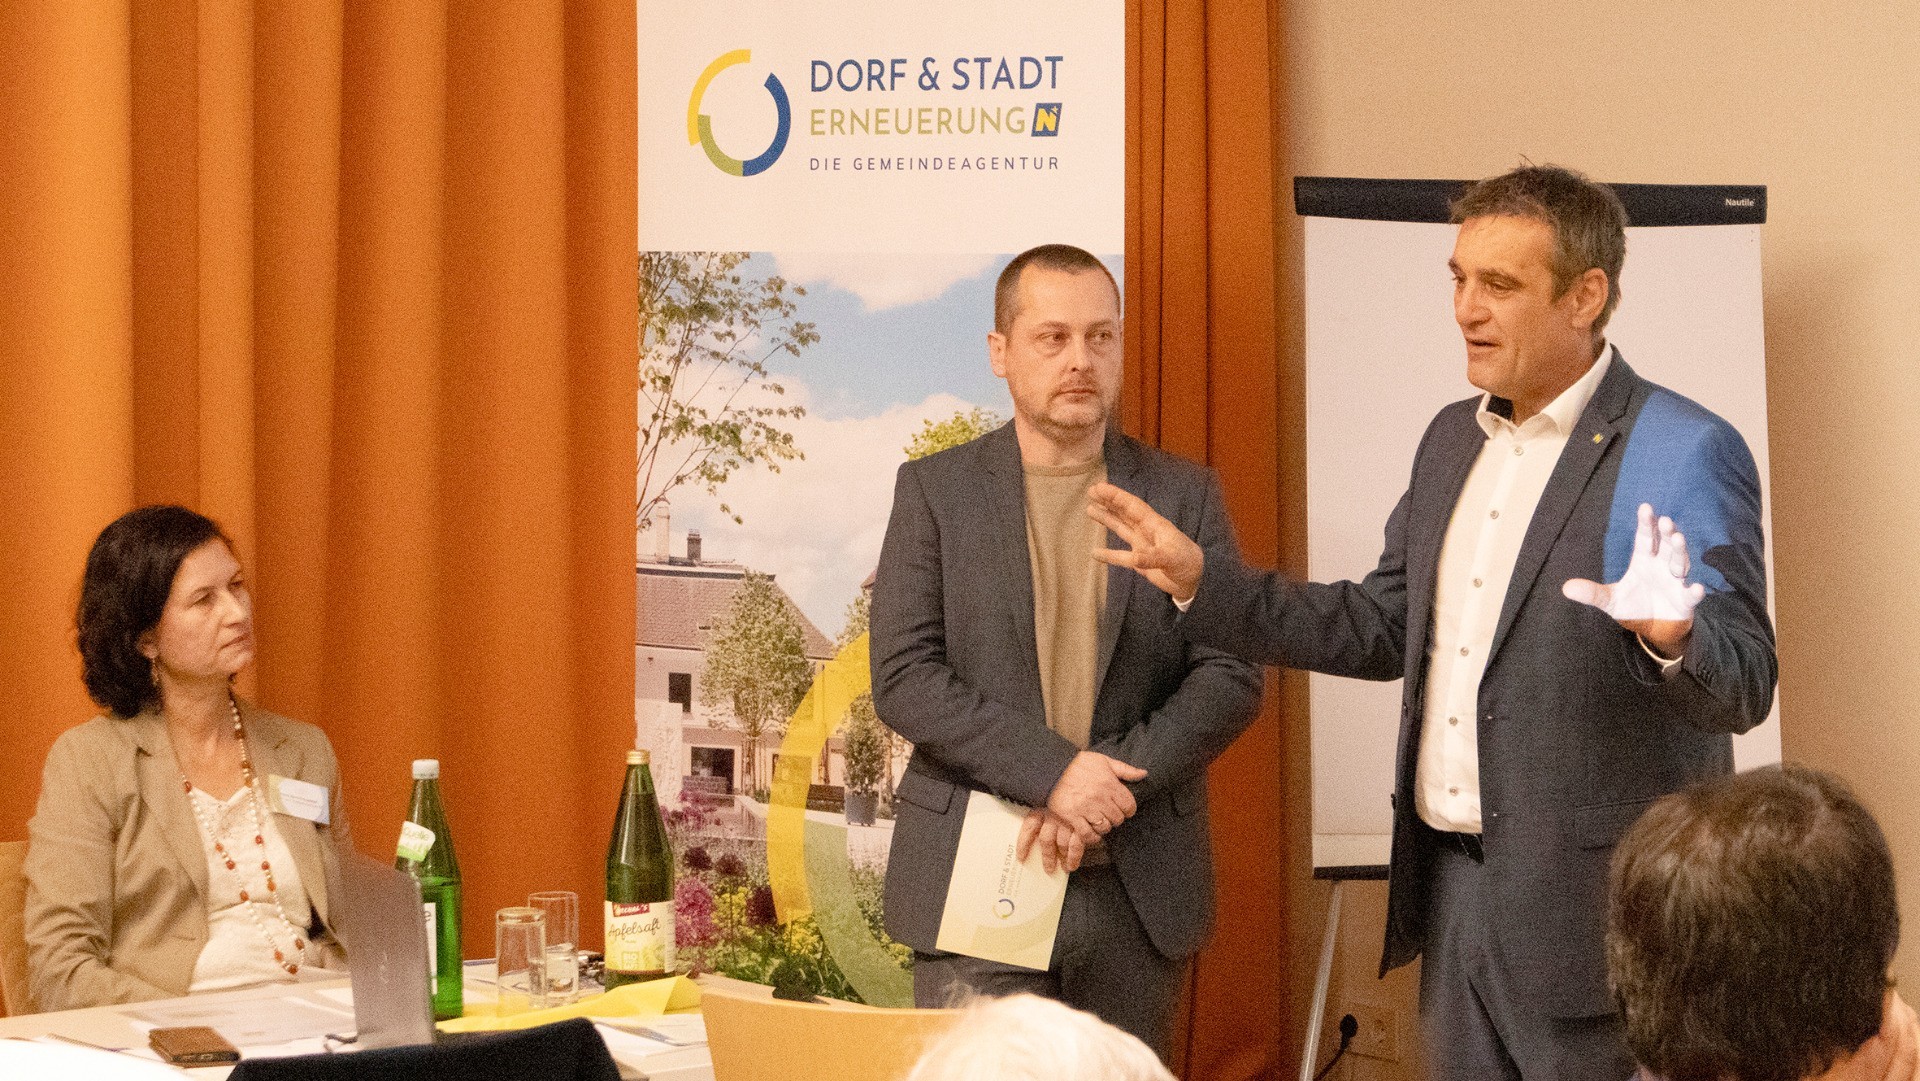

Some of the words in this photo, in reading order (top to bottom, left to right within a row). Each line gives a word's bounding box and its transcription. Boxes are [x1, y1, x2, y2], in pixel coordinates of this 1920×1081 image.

[810, 58, 907, 92] DORF
[918, 56, 940, 91] &
[952, 55, 1063, 90] STADT
[810, 106, 1025, 135] ERNEUERUNG
[810, 157, 841, 171] DIE
[853, 156, 1058, 171] GEMEINDEAGENTUR
[1725, 198, 1755, 207] Nautile
[998, 873, 1008, 895] DORF
[1005, 843, 1015, 866] STADT
[608, 917, 661, 941] Apfelsaft
